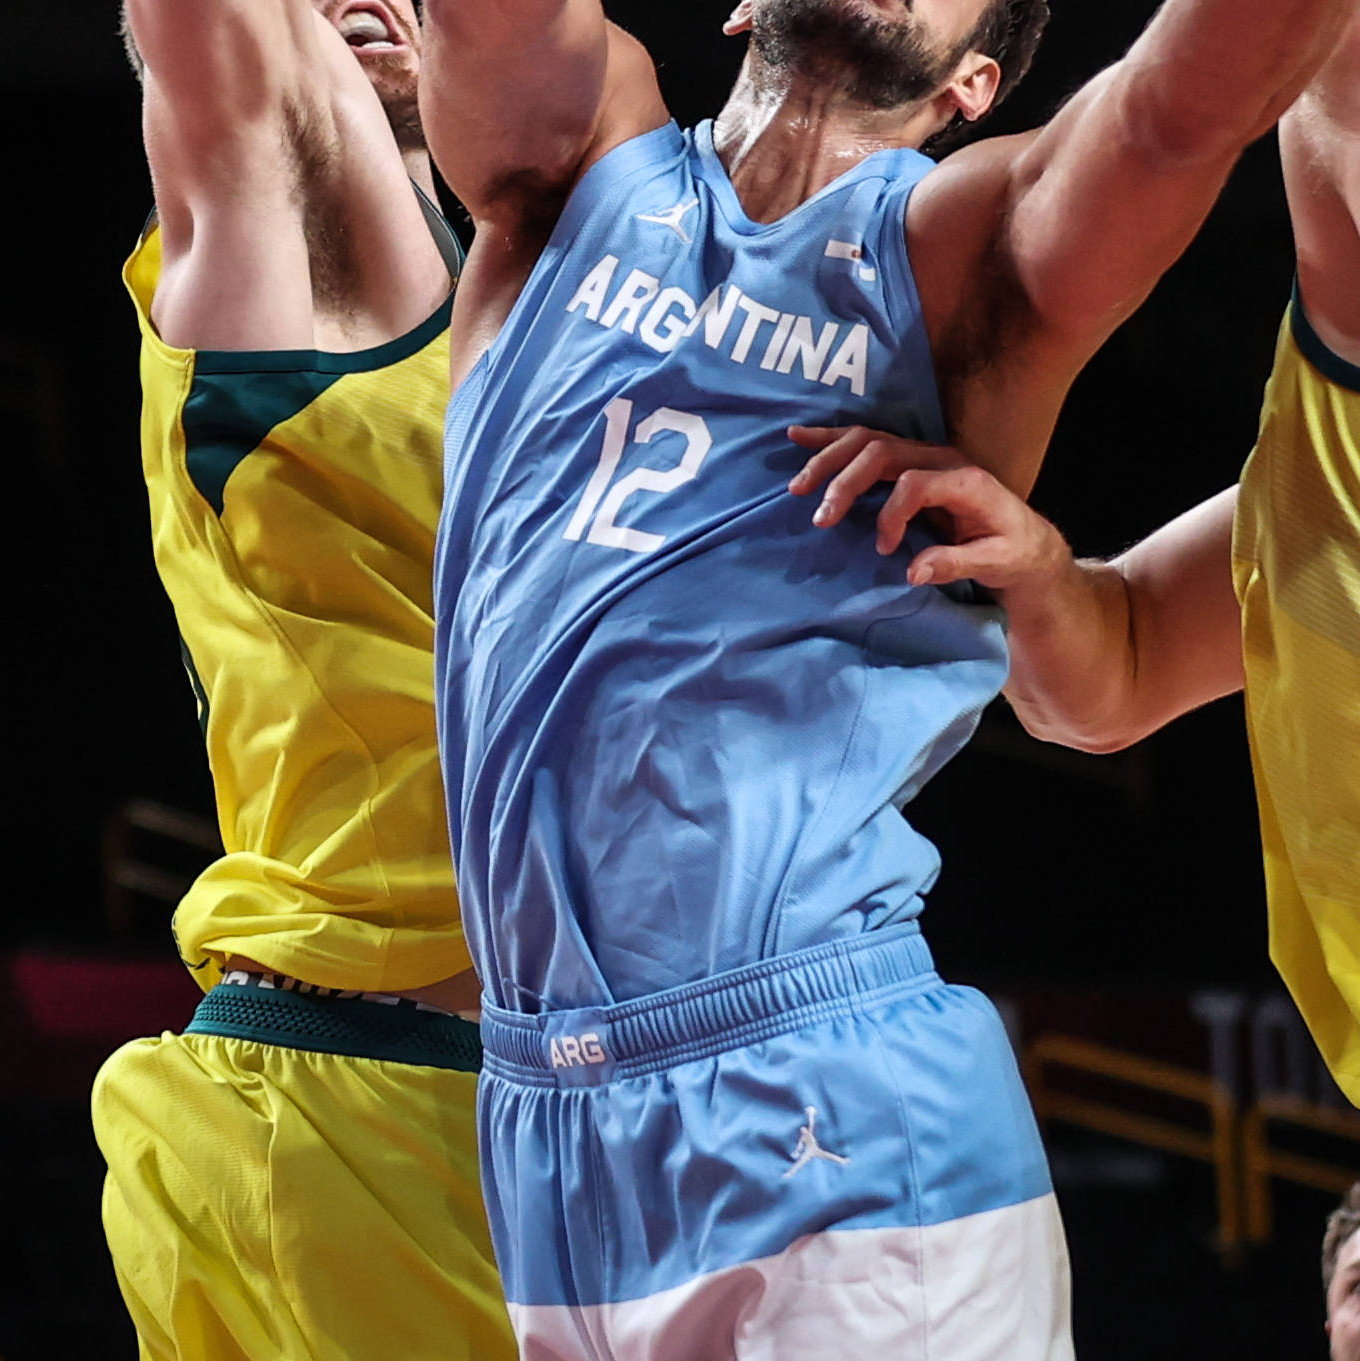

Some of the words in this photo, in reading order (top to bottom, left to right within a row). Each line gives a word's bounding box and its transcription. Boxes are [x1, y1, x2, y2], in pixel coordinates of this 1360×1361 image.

[565, 253, 870, 397] ARGNTINA
[562, 397, 712, 552] 12
[549, 1033, 606, 1069] ARG
